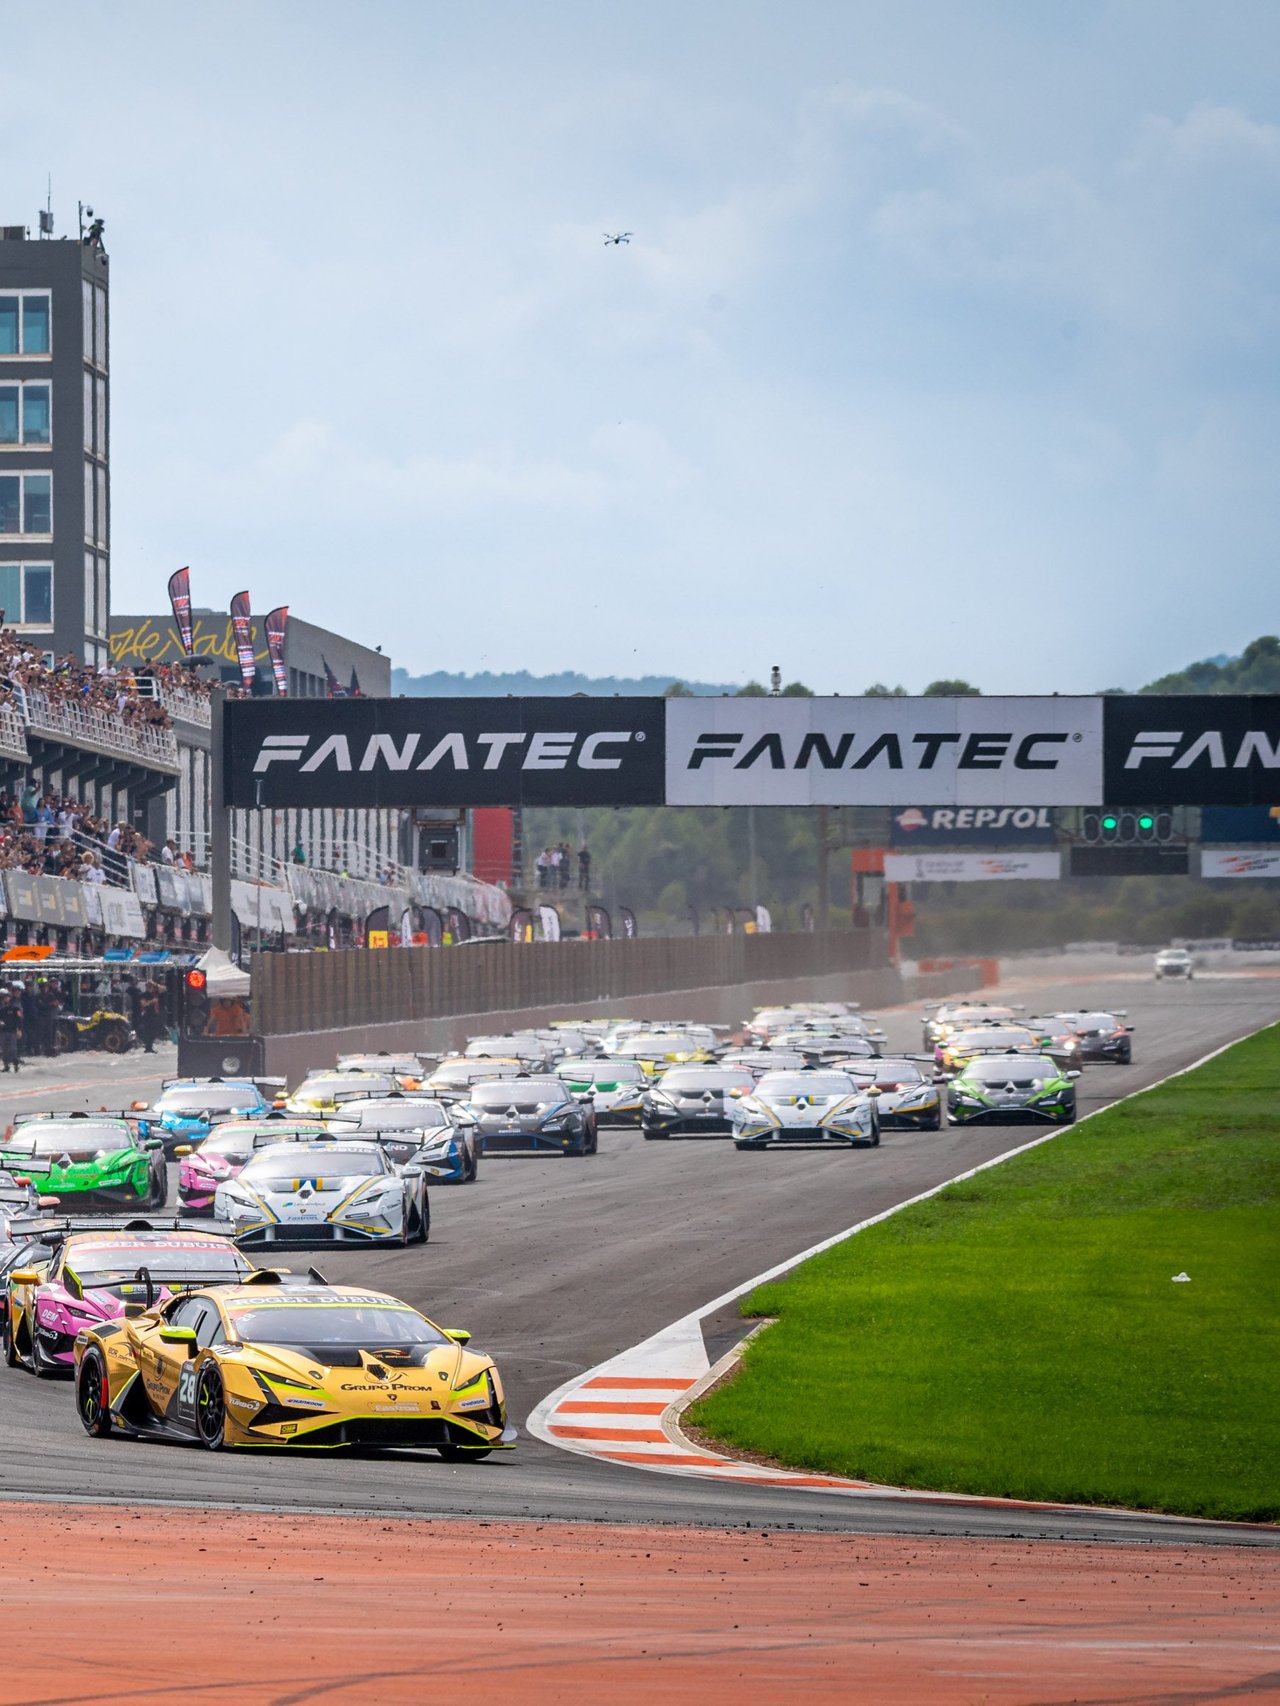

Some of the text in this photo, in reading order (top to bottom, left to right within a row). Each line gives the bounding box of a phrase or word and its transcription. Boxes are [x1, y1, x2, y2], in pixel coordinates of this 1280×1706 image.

[253, 732, 631, 772] FANATEC
[687, 733, 1068, 769] FANATEC
[931, 807, 1052, 829] REPSOL
[235, 1297, 401, 1305] ROGER DUBUIS
[180, 1372, 196, 1404] 28
